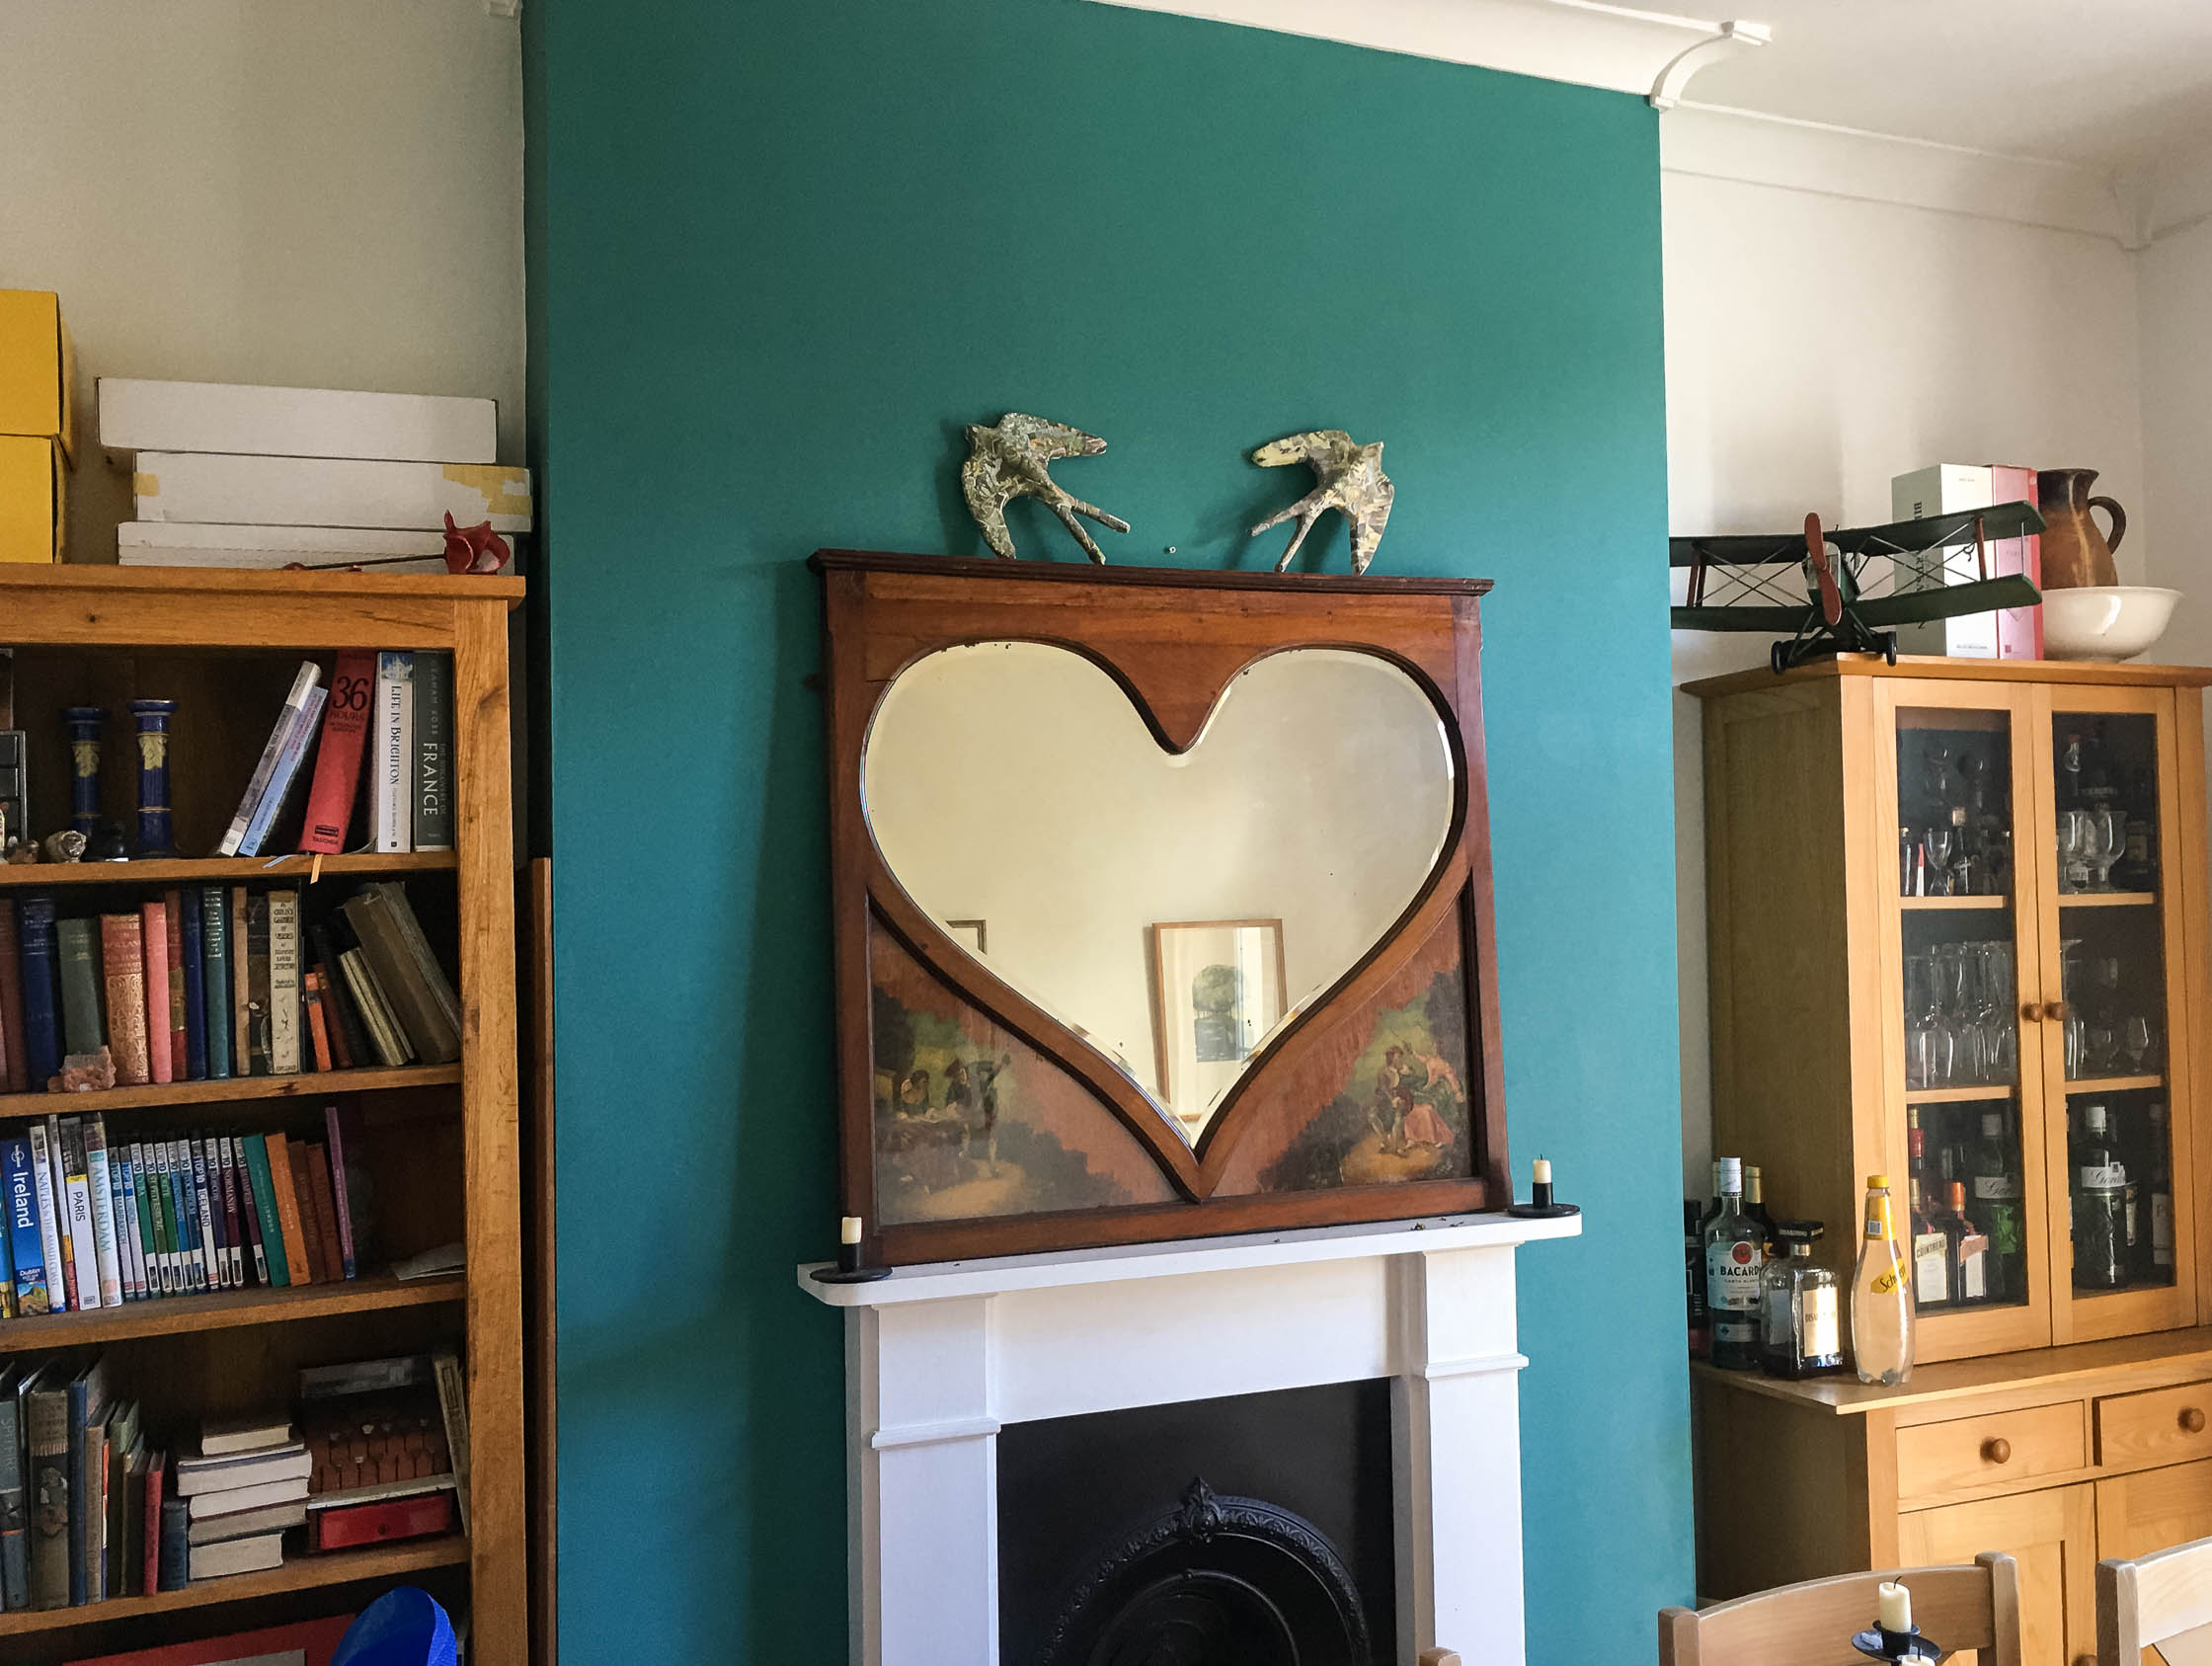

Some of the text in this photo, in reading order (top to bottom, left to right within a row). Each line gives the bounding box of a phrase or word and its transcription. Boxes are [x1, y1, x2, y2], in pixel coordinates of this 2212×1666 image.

[333, 676, 369, 711] 36
[390, 684, 402, 709] LIFE
[390, 712, 400, 723] IN
[388, 726, 401, 785] BRIGHTON
[422, 742, 438, 816] FRANCE
[11, 1170, 34, 1228] Ireland
[37, 1170, 51, 1210] NAPLES
[72, 1190, 86, 1222] PARIS
[91, 1165, 112, 1251] AMSTERDAM
[198, 1189, 211, 1228] ICELAND
[114, 1197, 127, 1244] MARRAKECH
[1720, 1265, 1759, 1277] BACARD
